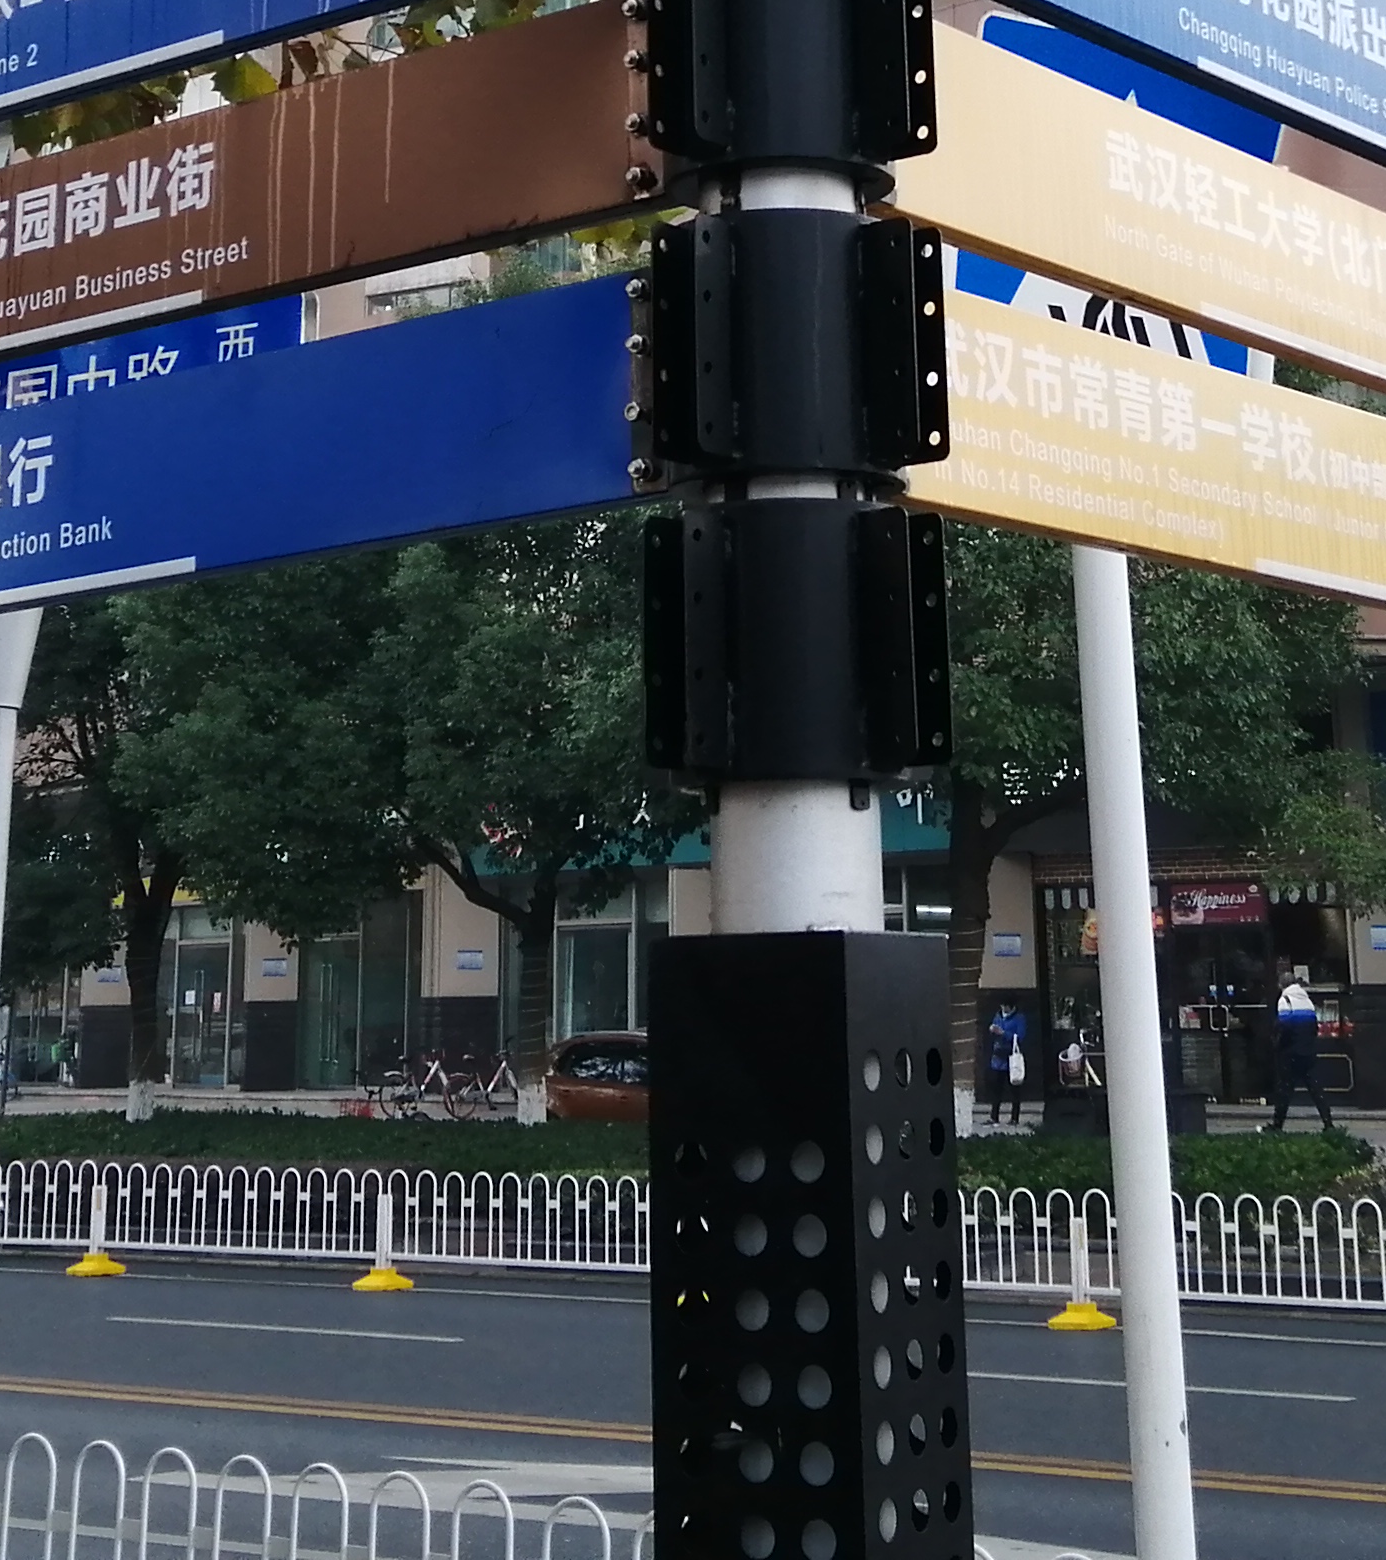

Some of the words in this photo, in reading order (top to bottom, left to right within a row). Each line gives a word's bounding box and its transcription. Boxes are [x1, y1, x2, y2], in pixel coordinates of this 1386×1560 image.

[25, 44, 39, 67] 2
[1179, 7, 1261, 68] Changqing
[1266, 46, 1330, 93] Huayuan
[1335, 77, 1378, 114] Police
[76, 268, 171, 300] Business
[181, 238, 248, 273] Street
[1104, 214, 1149, 251] North
[1158, 234, 1193, 268] Gate
[1200, 253, 1215, 272] of
[1220, 256, 1270, 292] Wuhan
[1275, 276, 1356, 327] Polytechnic
[950, 418, 1001, 450] uhan
[1011, 429, 1112, 482] Changqing
[1119, 457, 1160, 488] No.1
[1168, 468, 1257, 516] Secondary
[1263, 491, 1317, 525] School
[961, 458, 1019, 496] No.14
[1028, 474, 1134, 520] Residential
[1142, 500, 1224, 540] Complex)
[60, 516, 112, 548] Bank
